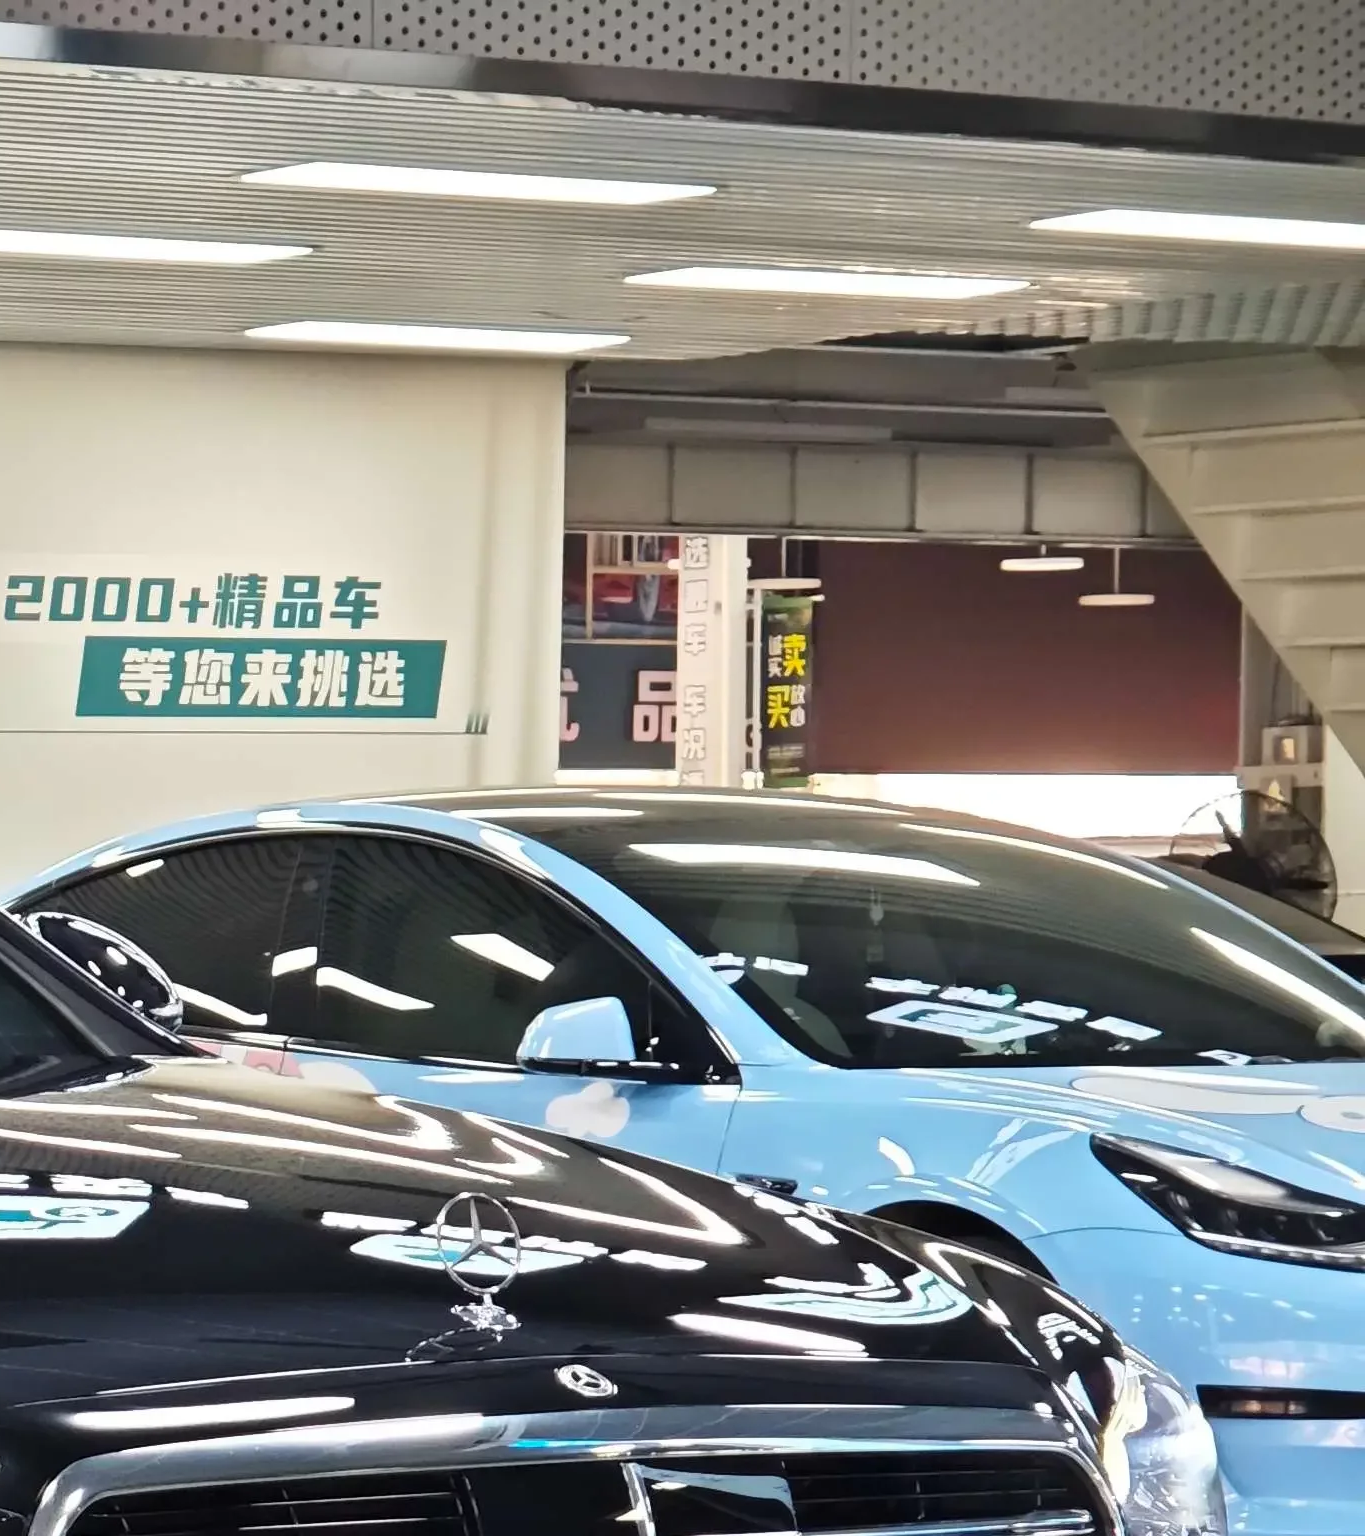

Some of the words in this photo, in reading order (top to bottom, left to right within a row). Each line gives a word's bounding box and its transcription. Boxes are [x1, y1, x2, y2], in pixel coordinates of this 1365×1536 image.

[4, 572, 382, 629] 2000+精品车
[119, 647, 406, 707] 等您来挑选
